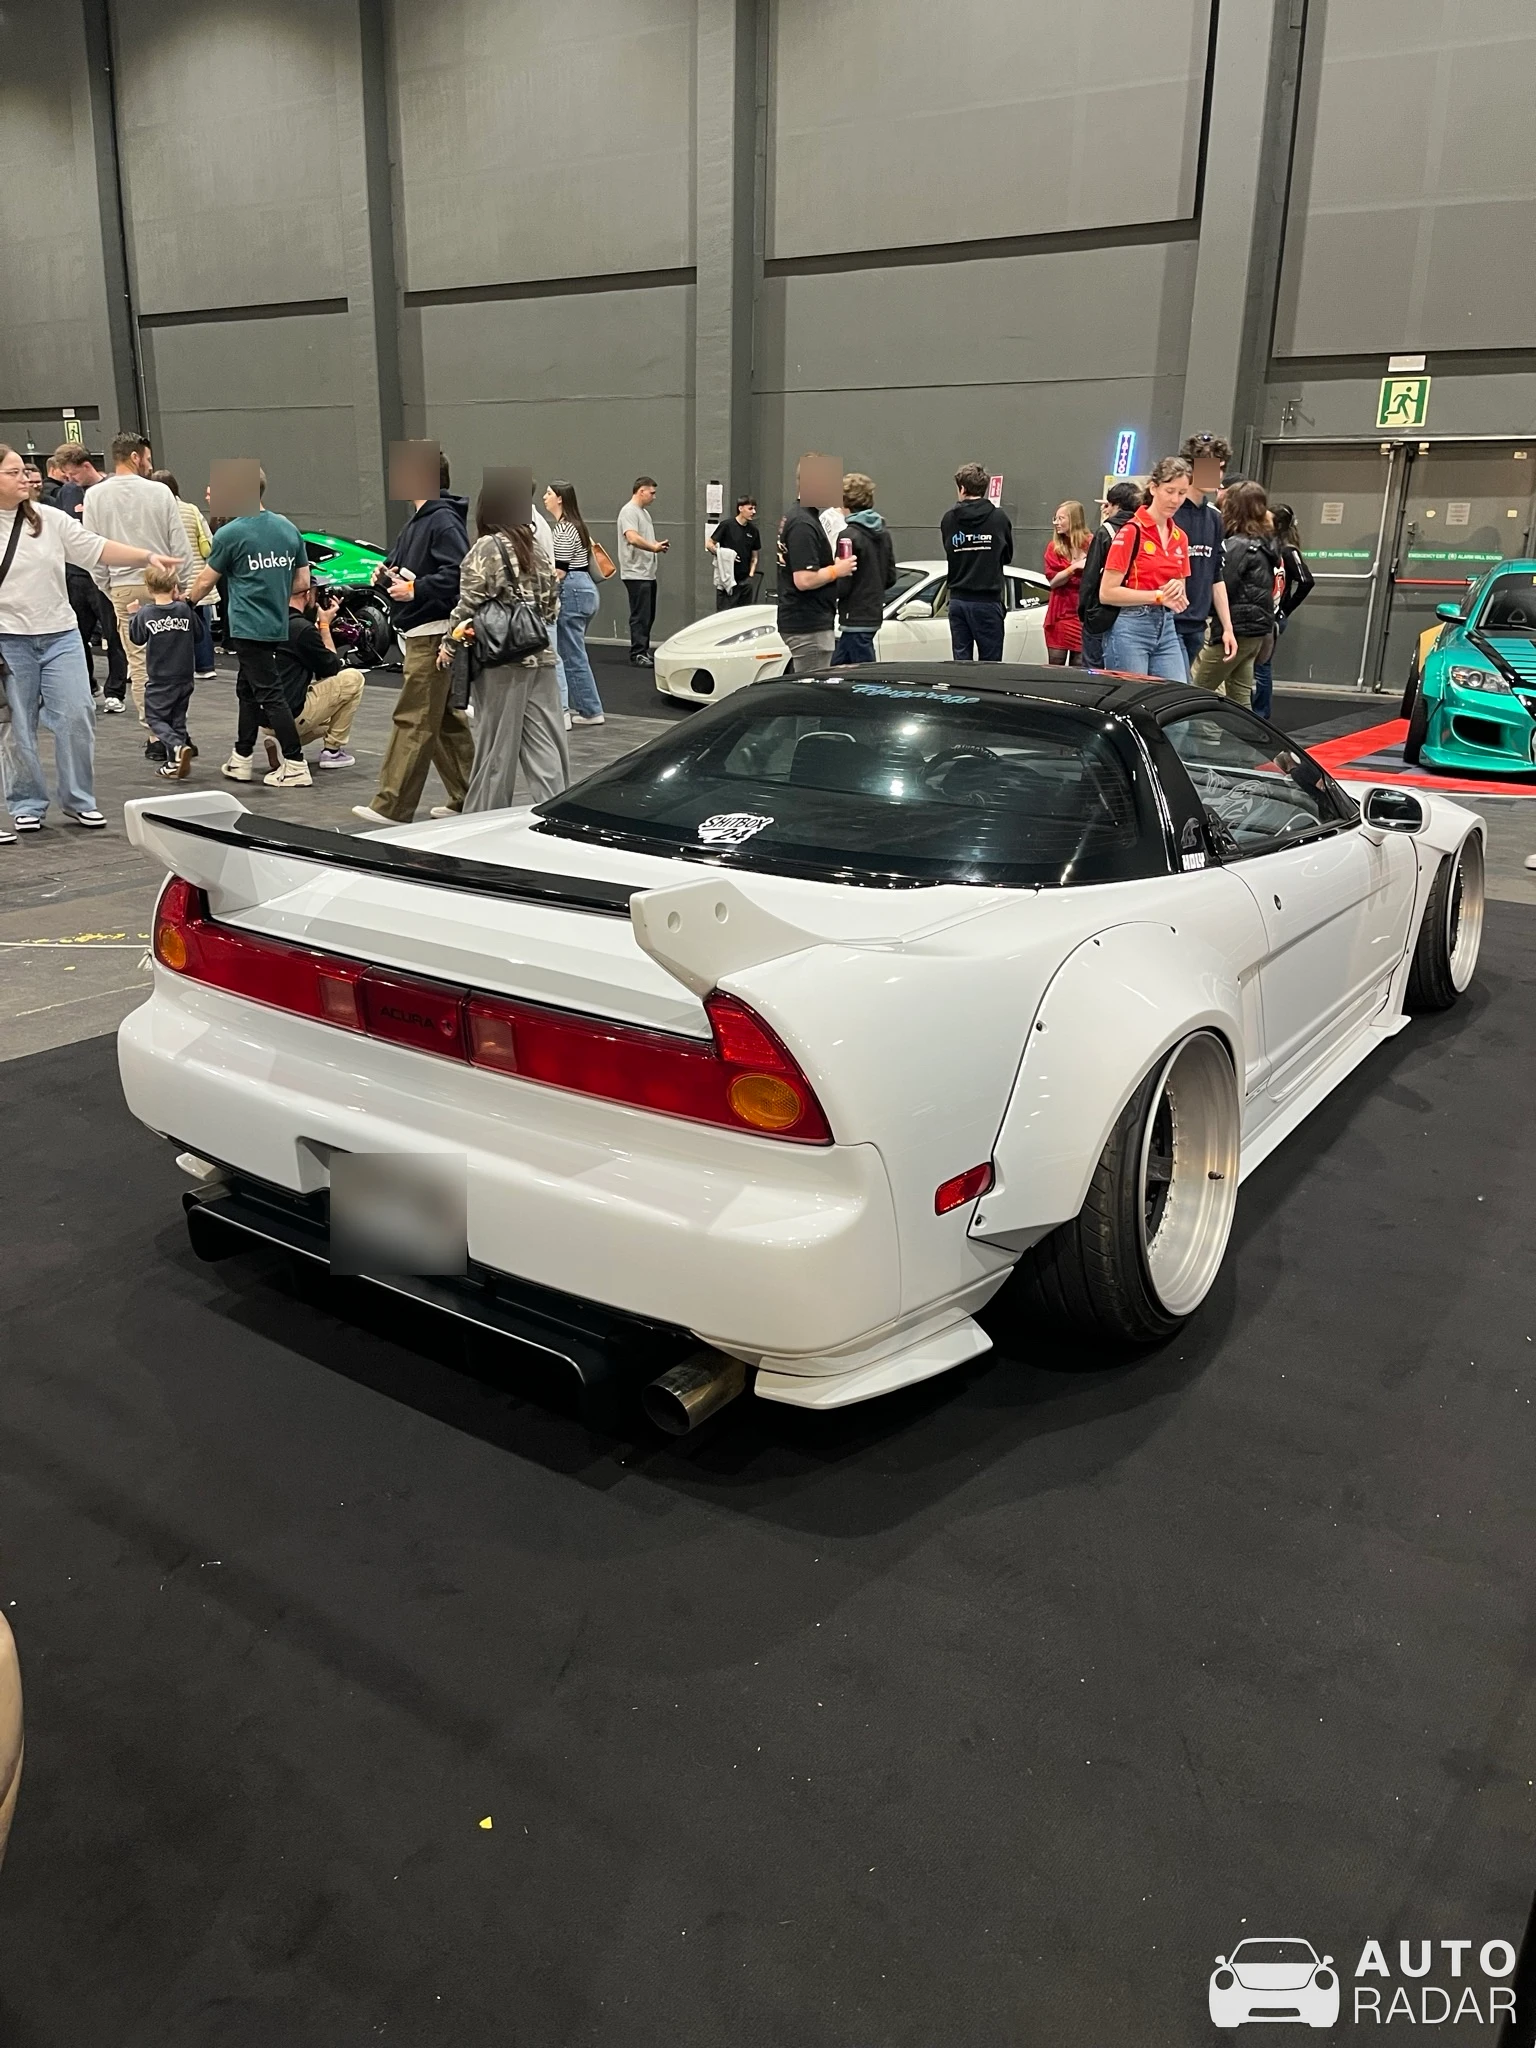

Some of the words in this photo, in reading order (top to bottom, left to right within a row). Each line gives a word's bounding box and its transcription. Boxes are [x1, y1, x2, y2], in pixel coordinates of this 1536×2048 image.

[1118, 434, 1130, 473] TATTOO
[702, 816, 772, 829] SHITBOX
[711, 828, 751, 841] 24
[1181, 852, 1205, 870] HOLY
[380, 1006, 437, 1030] ACURA
